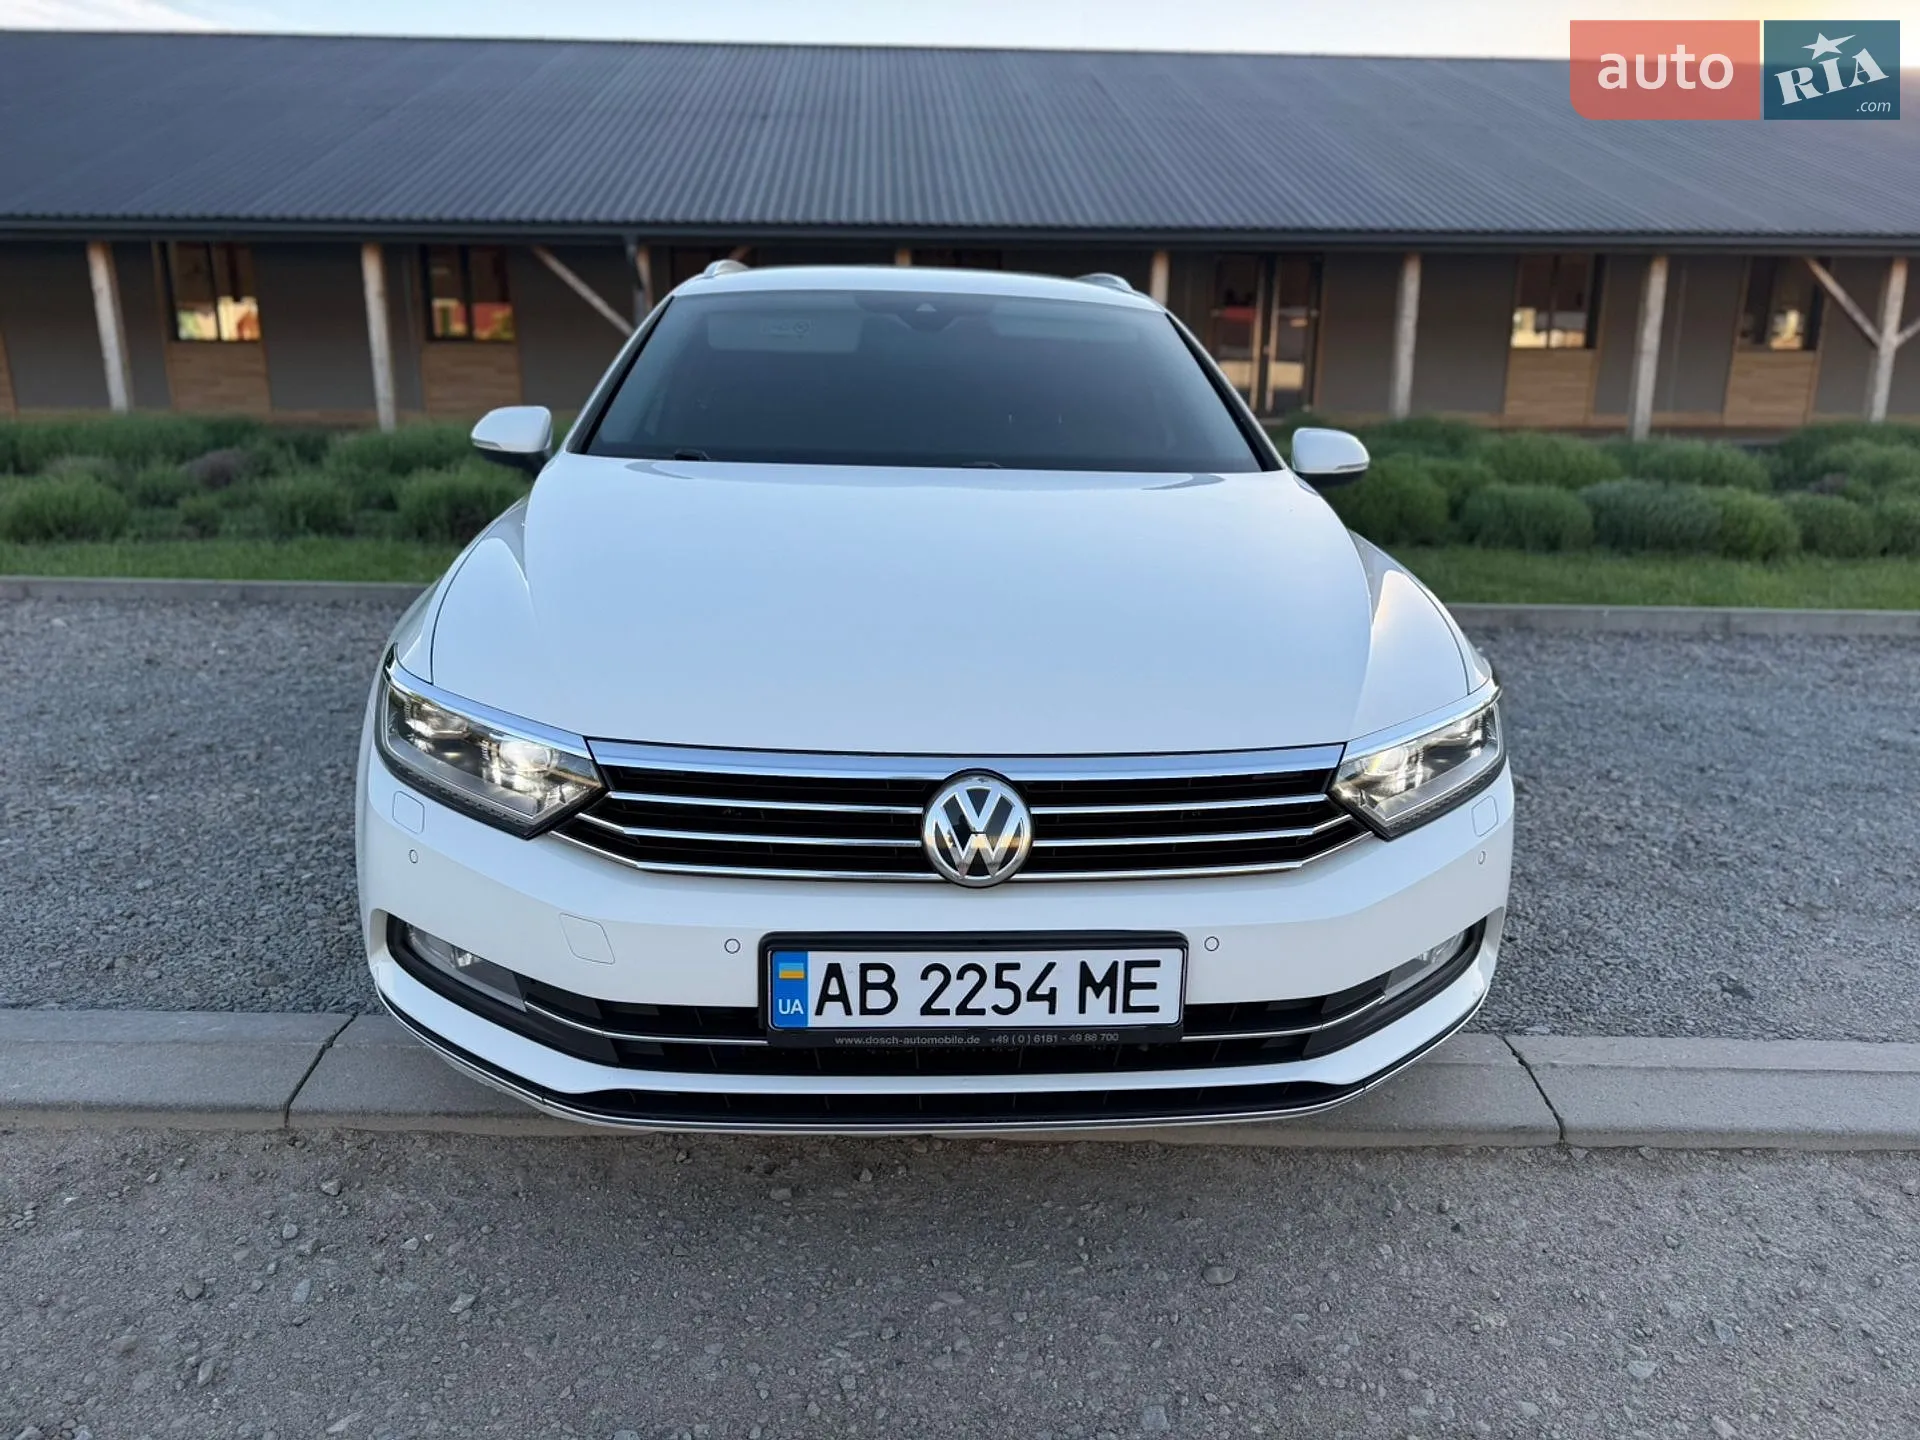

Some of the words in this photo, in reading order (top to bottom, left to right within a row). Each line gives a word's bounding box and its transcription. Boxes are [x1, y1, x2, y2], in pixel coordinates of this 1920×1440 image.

[814, 962, 899, 1016] AB
[919, 961, 1058, 1016] 2254
[1078, 959, 1161, 1014] ME
[778, 999, 804, 1015] UA
[834, 1034, 981, 1046] www.dosch-automobile.de
[990, 1034, 1010, 1044] +49
[1100, 1032, 1119, 1042] 700
